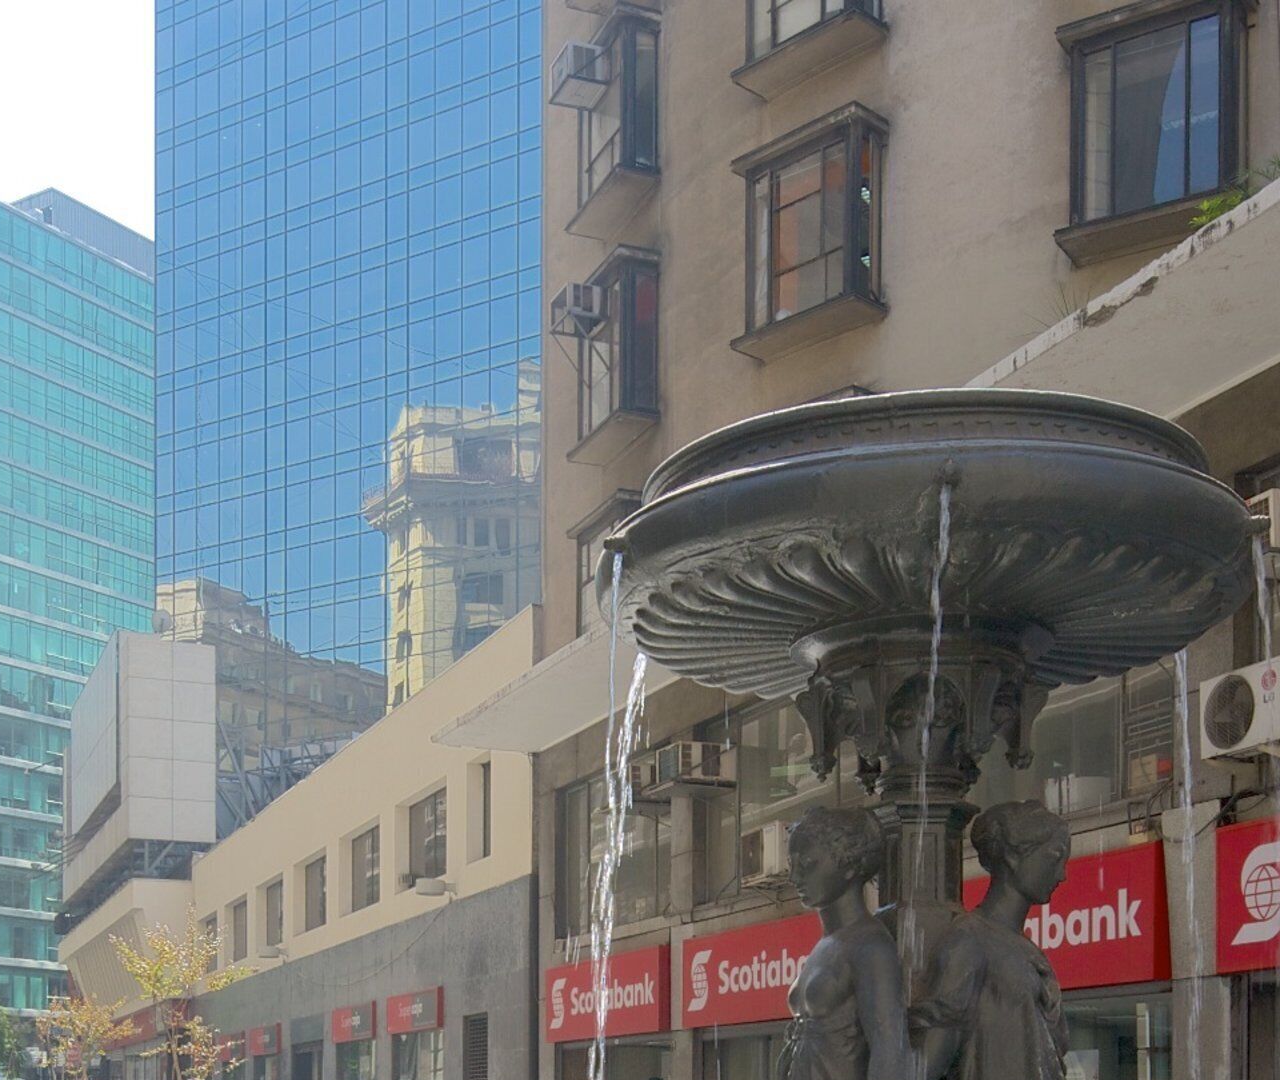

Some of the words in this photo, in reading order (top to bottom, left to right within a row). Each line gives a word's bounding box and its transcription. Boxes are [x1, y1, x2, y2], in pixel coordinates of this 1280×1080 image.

[1024, 888, 1142, 950] abank
[570, 972, 655, 1016] Scotabank
[718, 948, 809, 995] Scotiab
